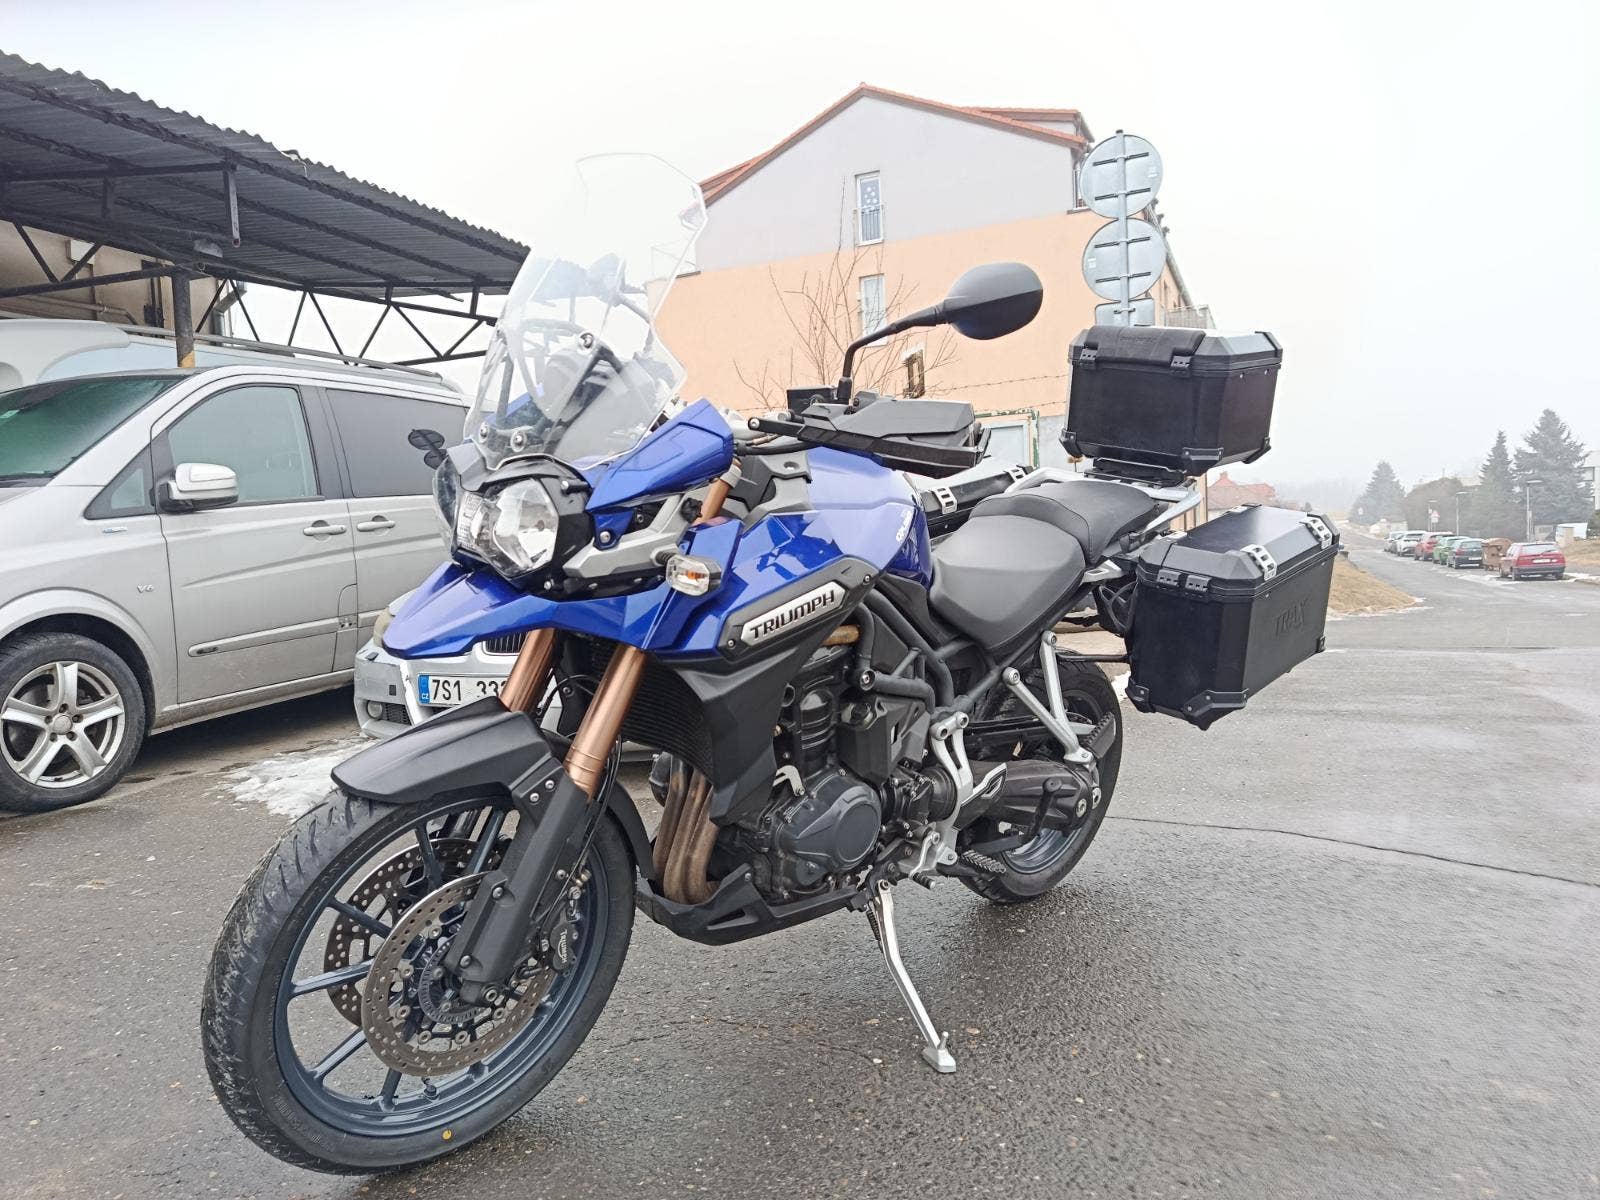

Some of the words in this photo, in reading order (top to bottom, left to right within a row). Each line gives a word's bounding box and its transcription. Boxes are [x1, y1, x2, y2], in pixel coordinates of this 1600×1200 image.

[750, 589, 835, 639] TRIUMPH
[432, 679, 462, 702] 7S1
[476, 680, 507, 698] 33
